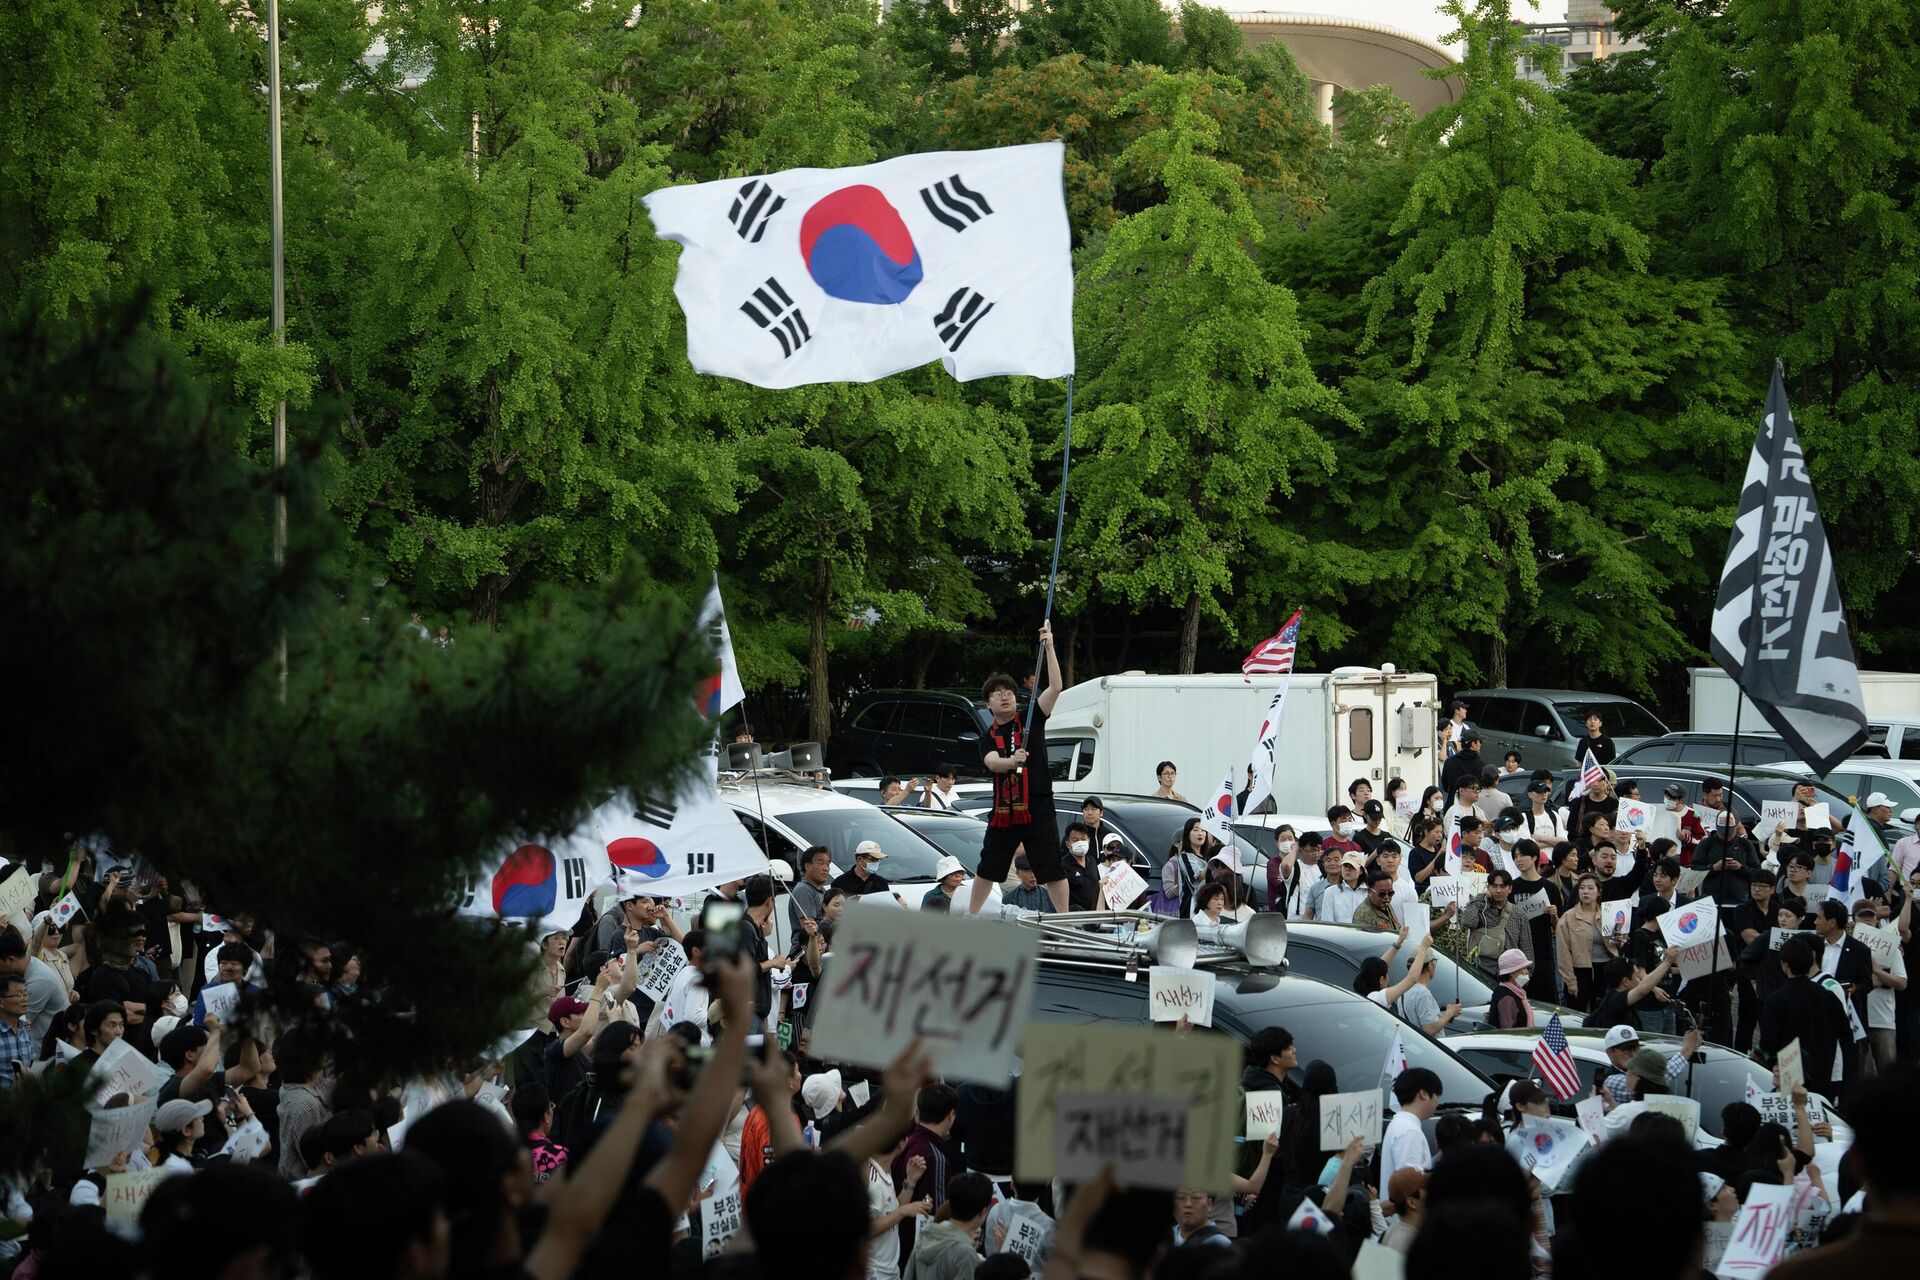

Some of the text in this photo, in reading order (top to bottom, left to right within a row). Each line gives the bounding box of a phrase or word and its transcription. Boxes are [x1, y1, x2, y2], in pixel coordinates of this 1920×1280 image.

[659, 944, 677, 968] 진실을
[1857, 931, 1893, 957] 재선거
[645, 967, 663, 990] 밝혀라
[655, 954, 683, 993] 부정선거
[832, 941, 1029, 1051] 재선거
[1156, 984, 1203, 1008] 재선거
[1064, 1105, 1188, 1161] 재선거
[1322, 1099, 1378, 1145] 재선거
